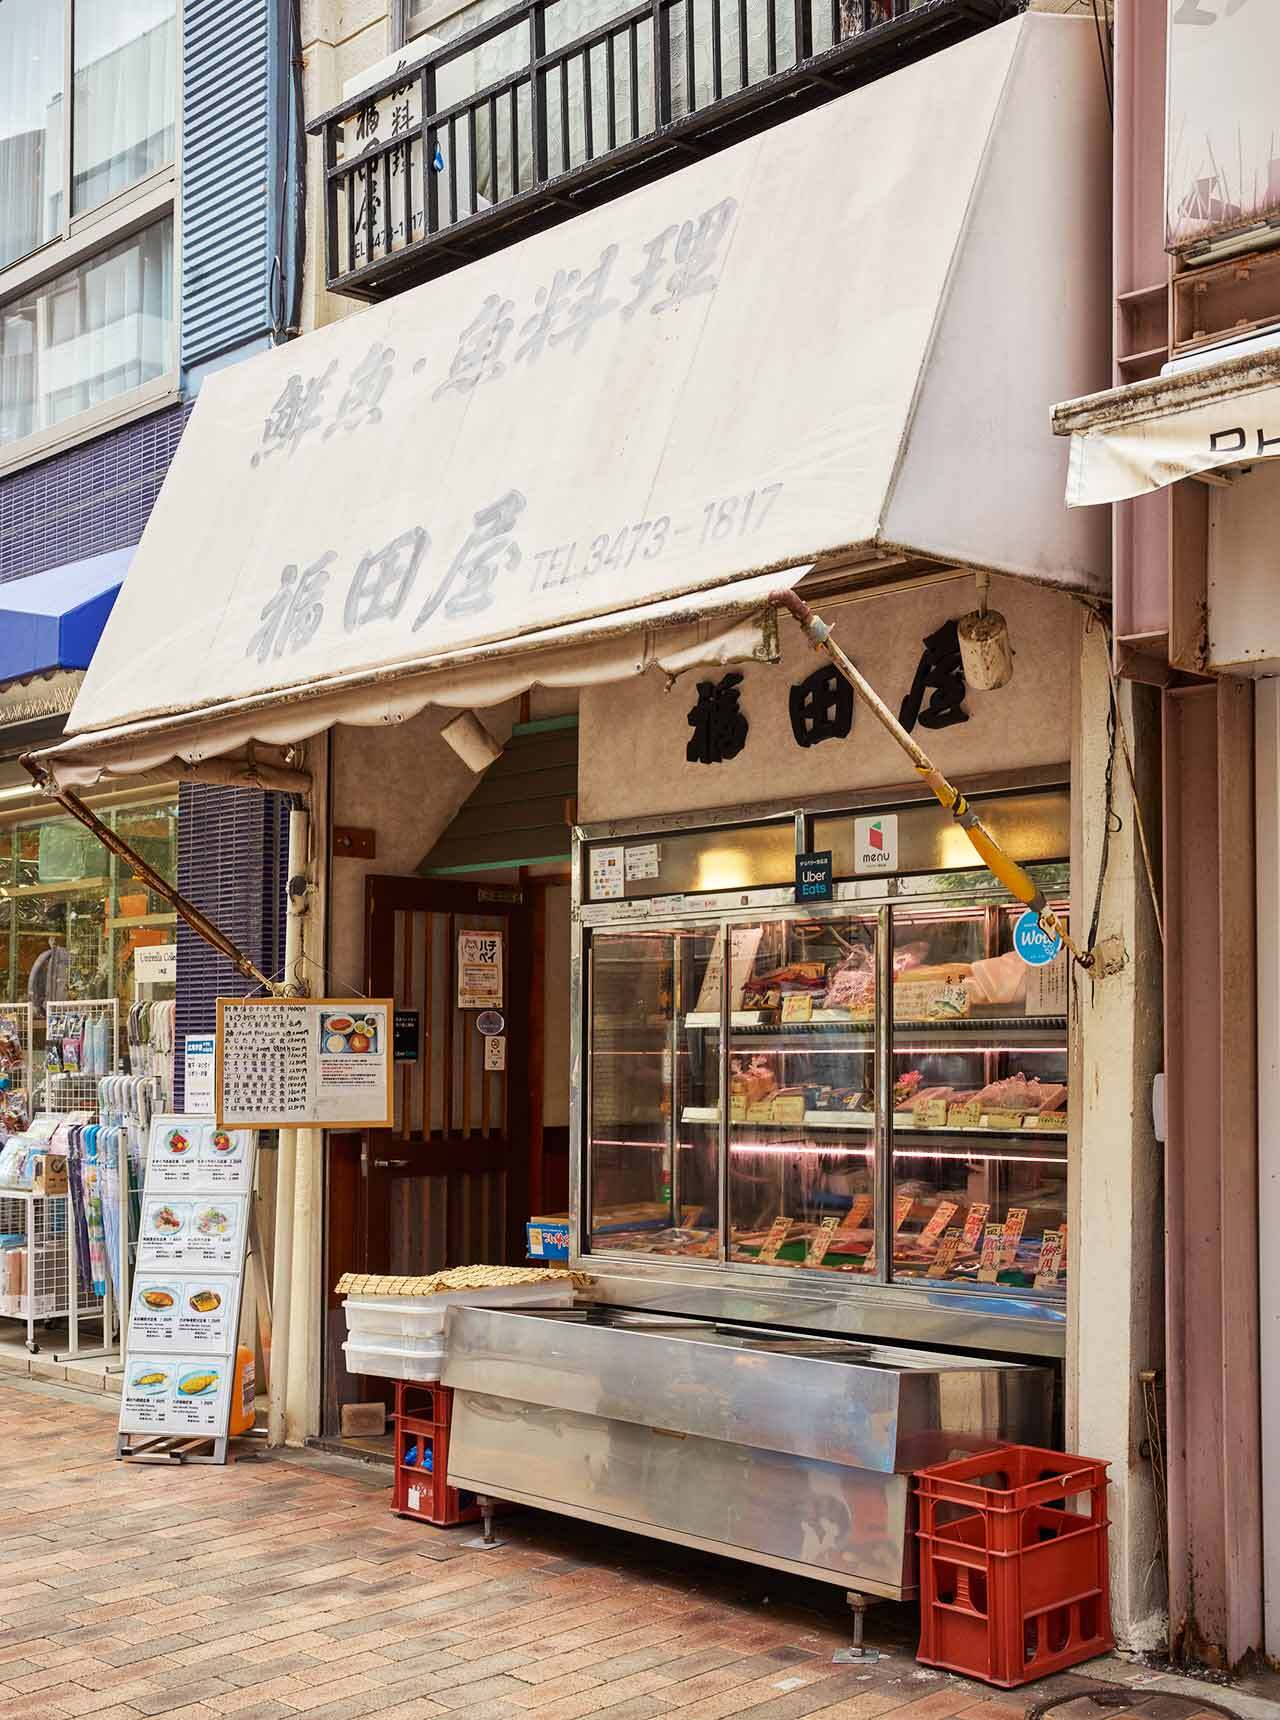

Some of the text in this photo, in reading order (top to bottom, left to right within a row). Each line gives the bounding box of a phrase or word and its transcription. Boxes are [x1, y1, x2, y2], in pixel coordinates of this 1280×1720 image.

[862, 852, 891, 863] menu
[802, 871, 826, 883] Uber
[802, 883, 827, 896] Eats
[479, 940, 497, 952] ハチ
[479, 952, 497, 963] ペイ
